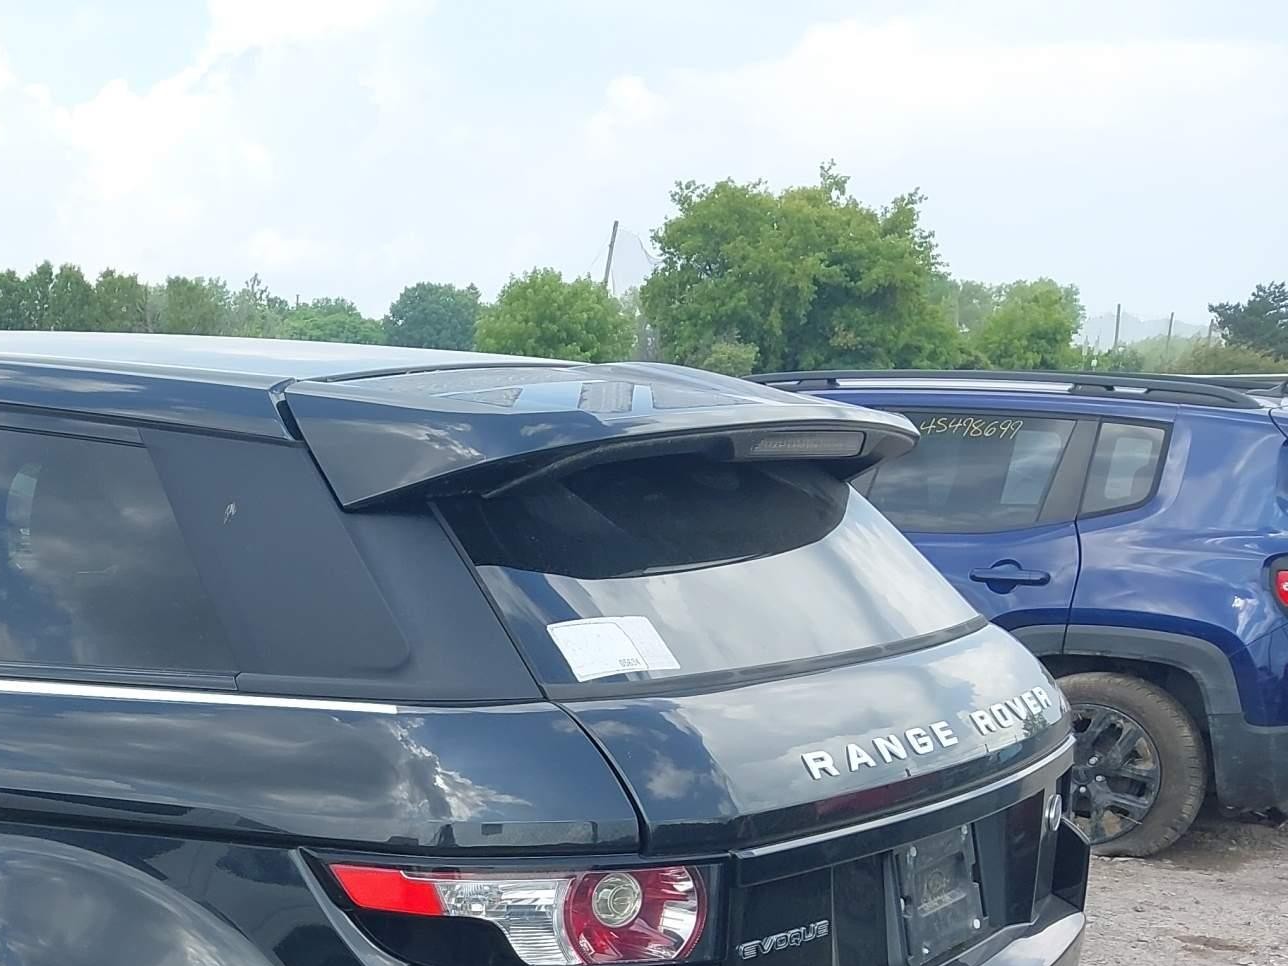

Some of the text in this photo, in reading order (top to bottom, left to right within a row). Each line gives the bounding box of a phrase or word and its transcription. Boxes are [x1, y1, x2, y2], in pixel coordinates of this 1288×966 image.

[800, 686, 1053, 780] RANGE ROVER
[737, 919, 830, 960] EVOQUE
